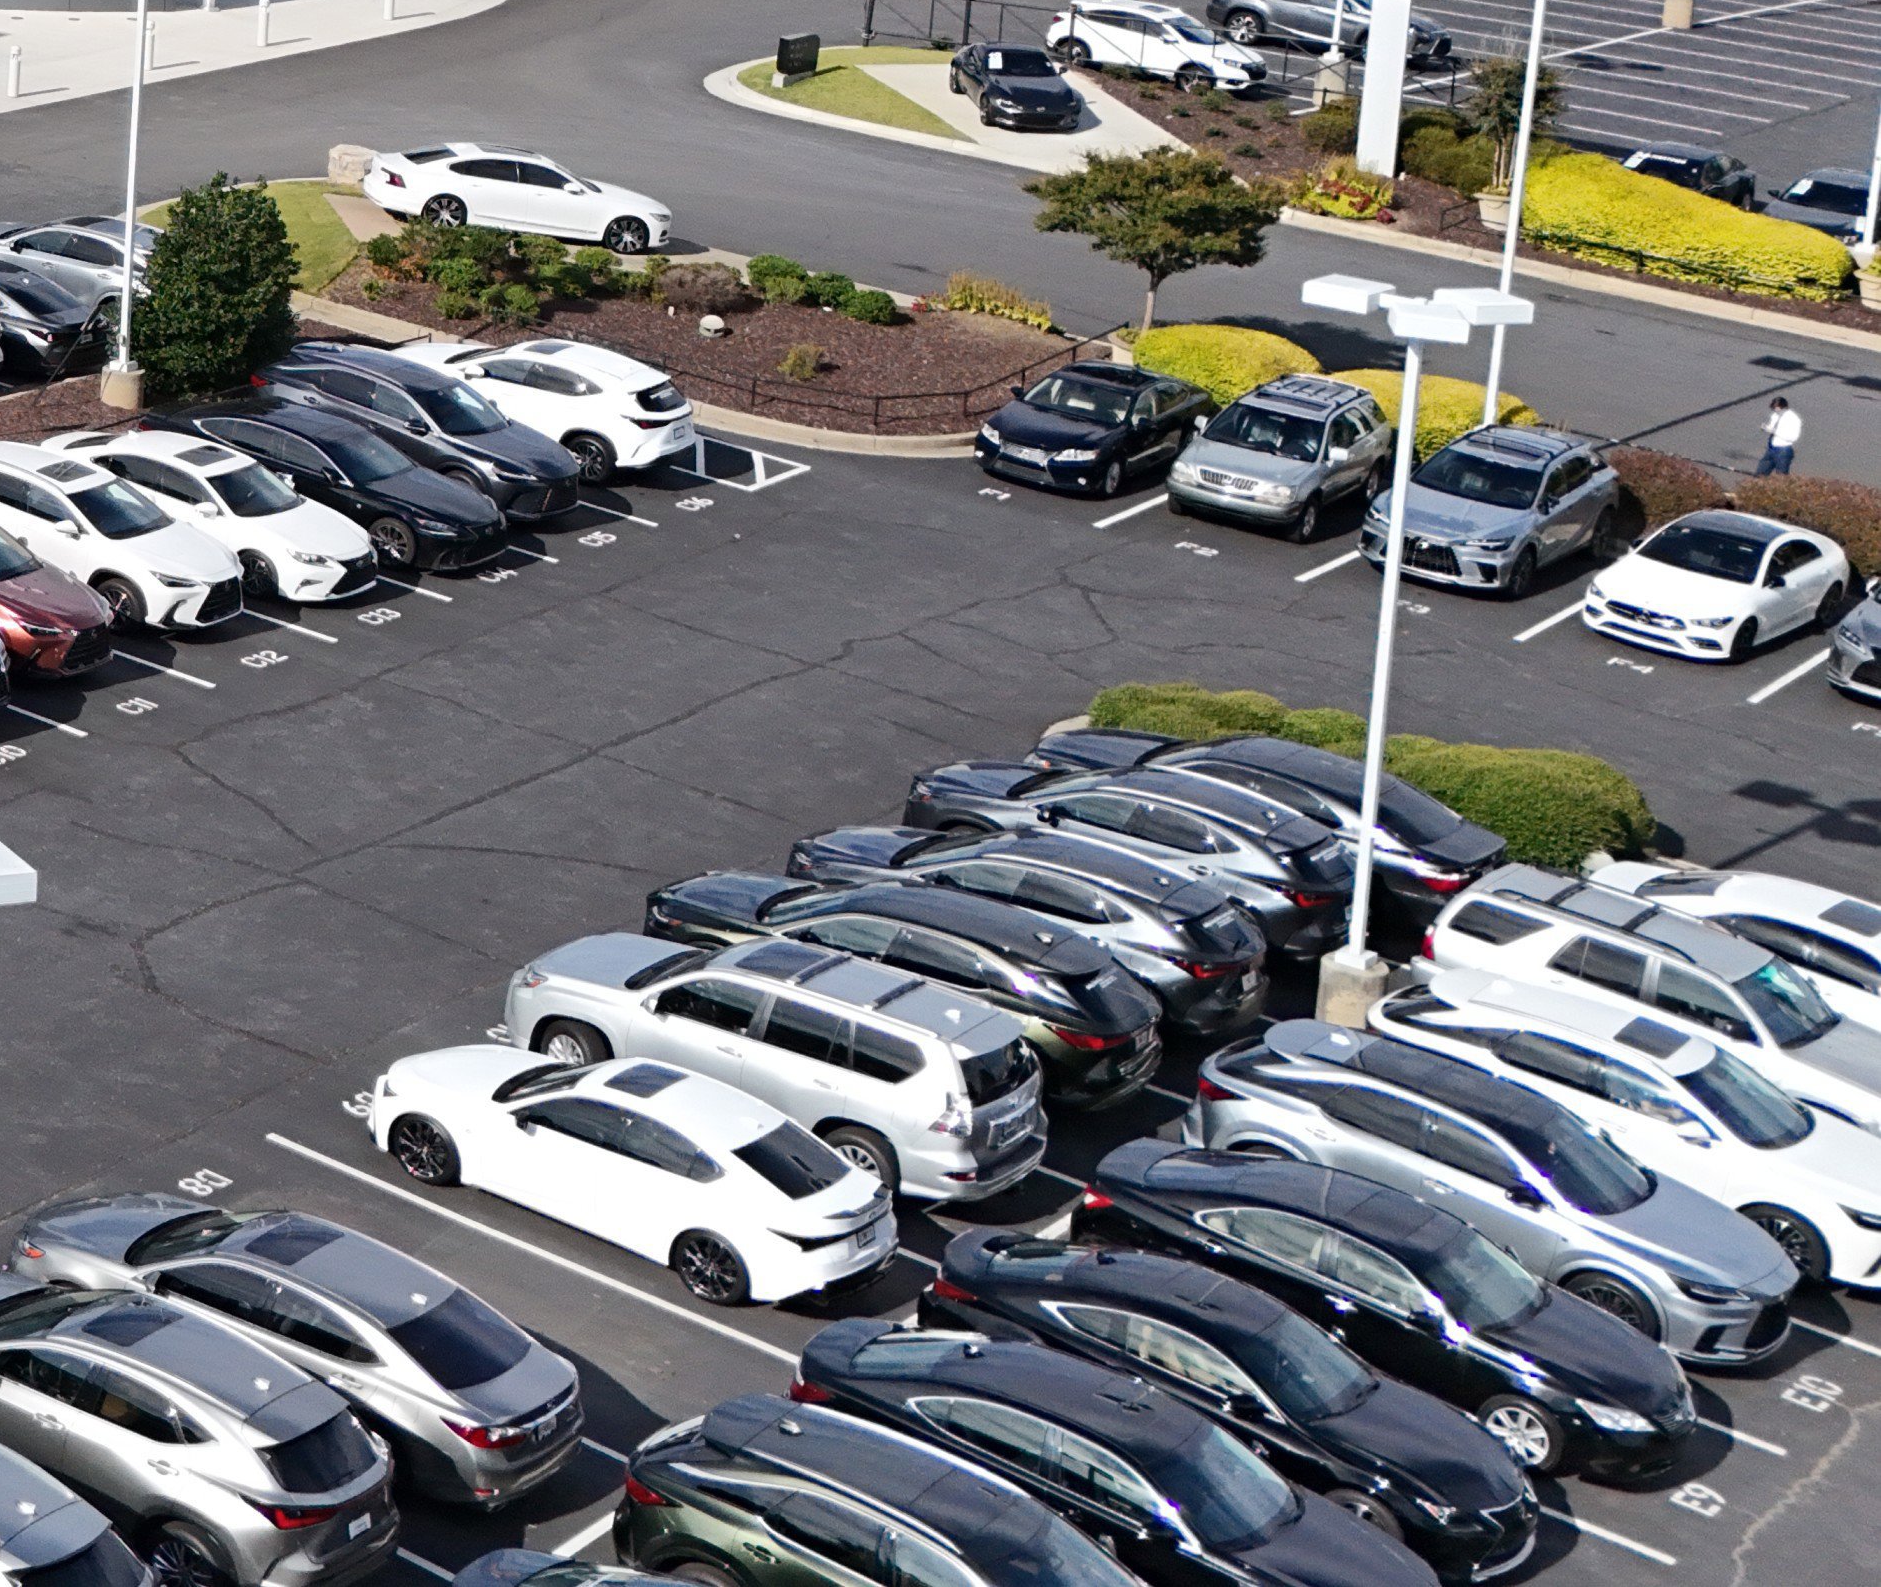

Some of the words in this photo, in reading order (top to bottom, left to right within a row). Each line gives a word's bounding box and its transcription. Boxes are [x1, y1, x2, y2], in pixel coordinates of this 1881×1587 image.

[577, 530, 618, 548] C15
[356, 607, 403, 626] C13
[239, 649, 290, 669] C12
[114, 696, 161, 716] C11
[1781, 1375, 1844, 1413] E10
[1668, 1482, 1727, 1517] E9
